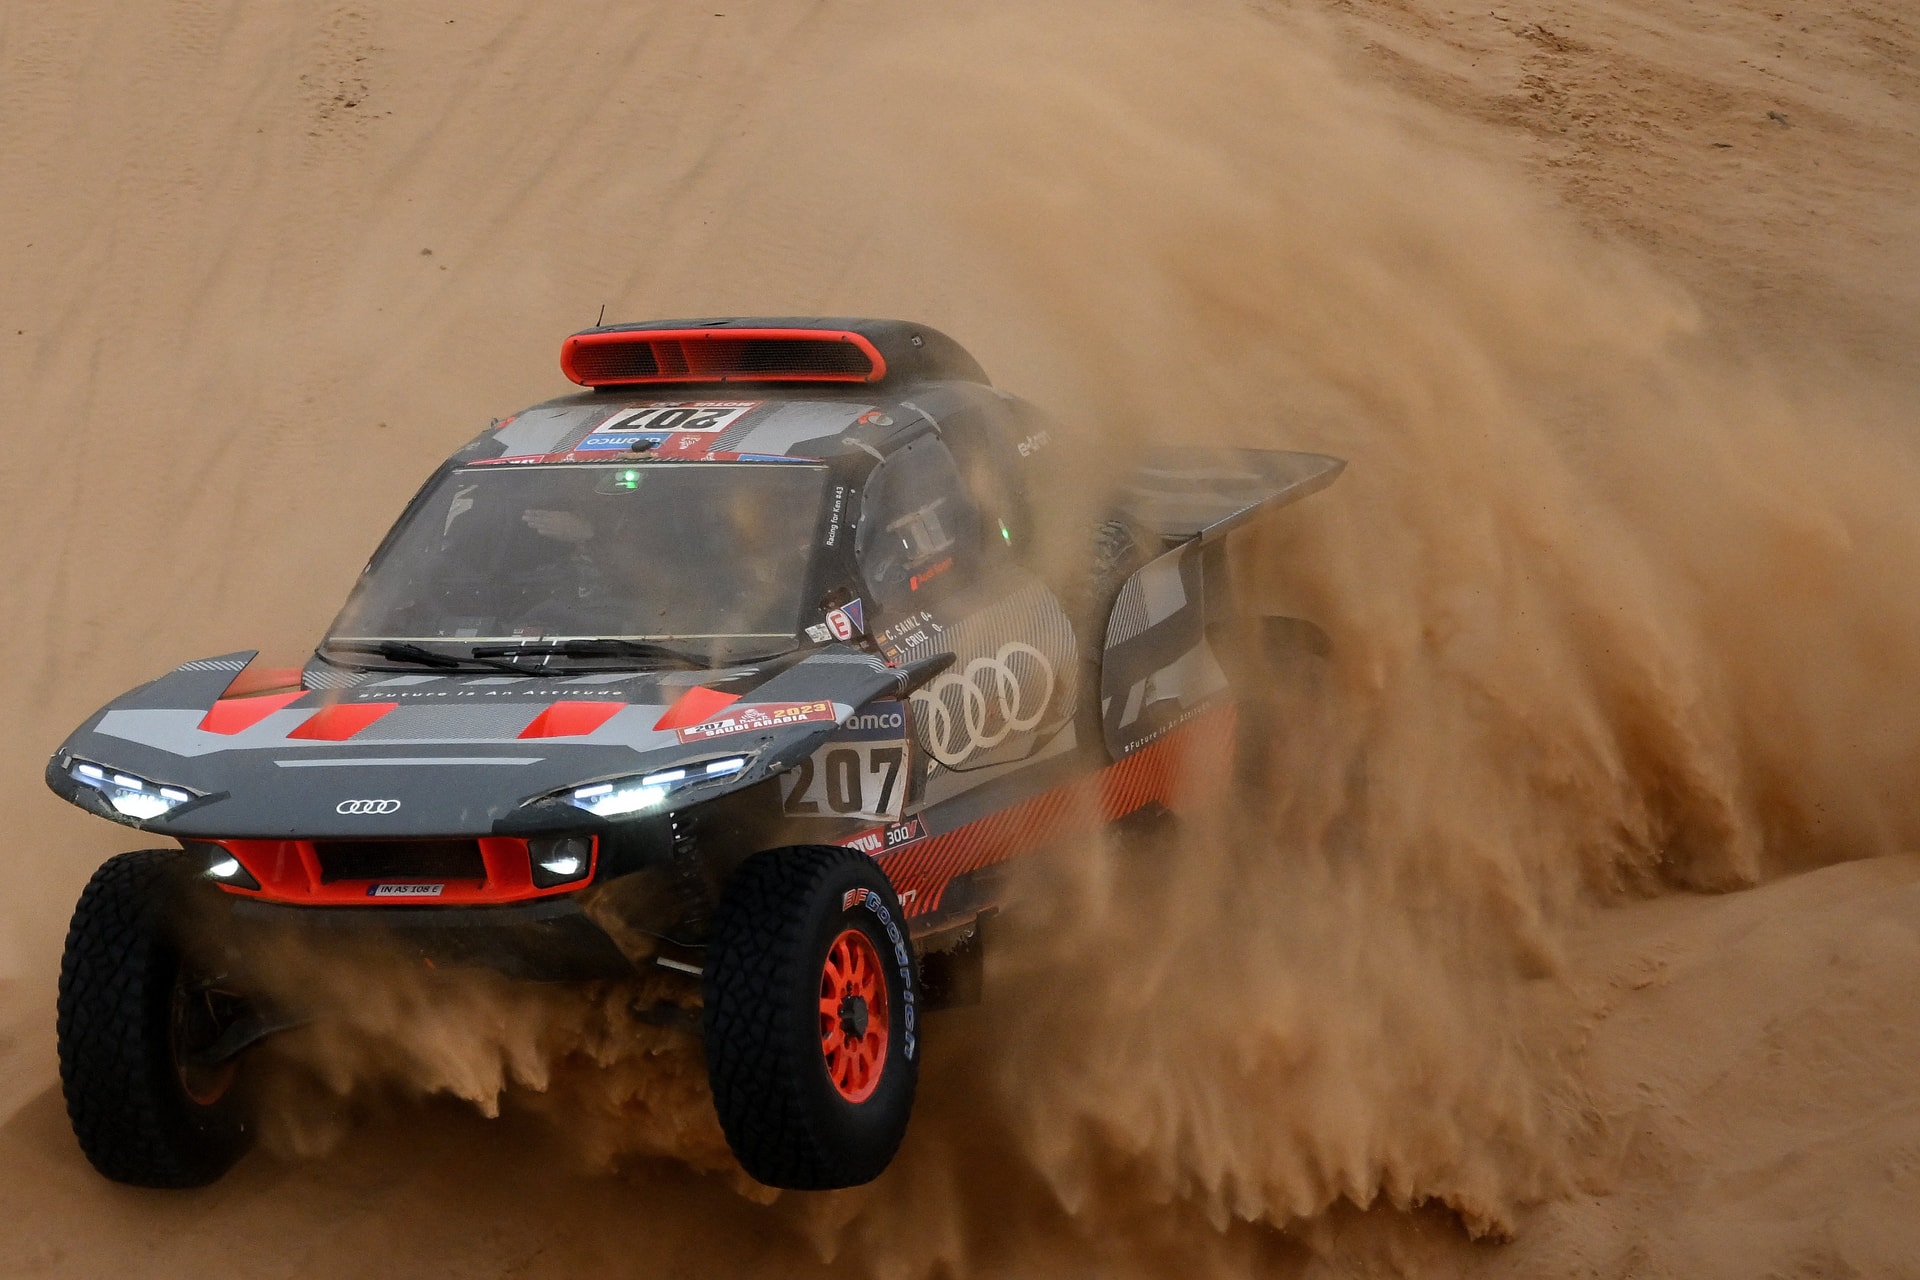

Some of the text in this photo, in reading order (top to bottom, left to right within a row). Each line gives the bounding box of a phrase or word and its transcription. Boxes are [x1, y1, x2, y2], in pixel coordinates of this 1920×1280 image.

[608, 408, 737, 430] 207
[586, 437, 662, 445] aamco
[826, 486, 844, 546] Racing for Ken #43
[830, 613, 849, 637] E
[885, 629, 897, 641] C.
[894, 615, 921, 636] SAINZ
[895, 644, 908, 655] L.
[904, 630, 929, 648] CRUZ
[773, 703, 828, 719] 2023
[845, 713, 902, 731] amco
[695, 722, 725, 733] 207
[705, 714, 808, 738] SAUDI ARABIA
[784, 747, 903, 814] 207
[886, 819, 918, 846] 300V
